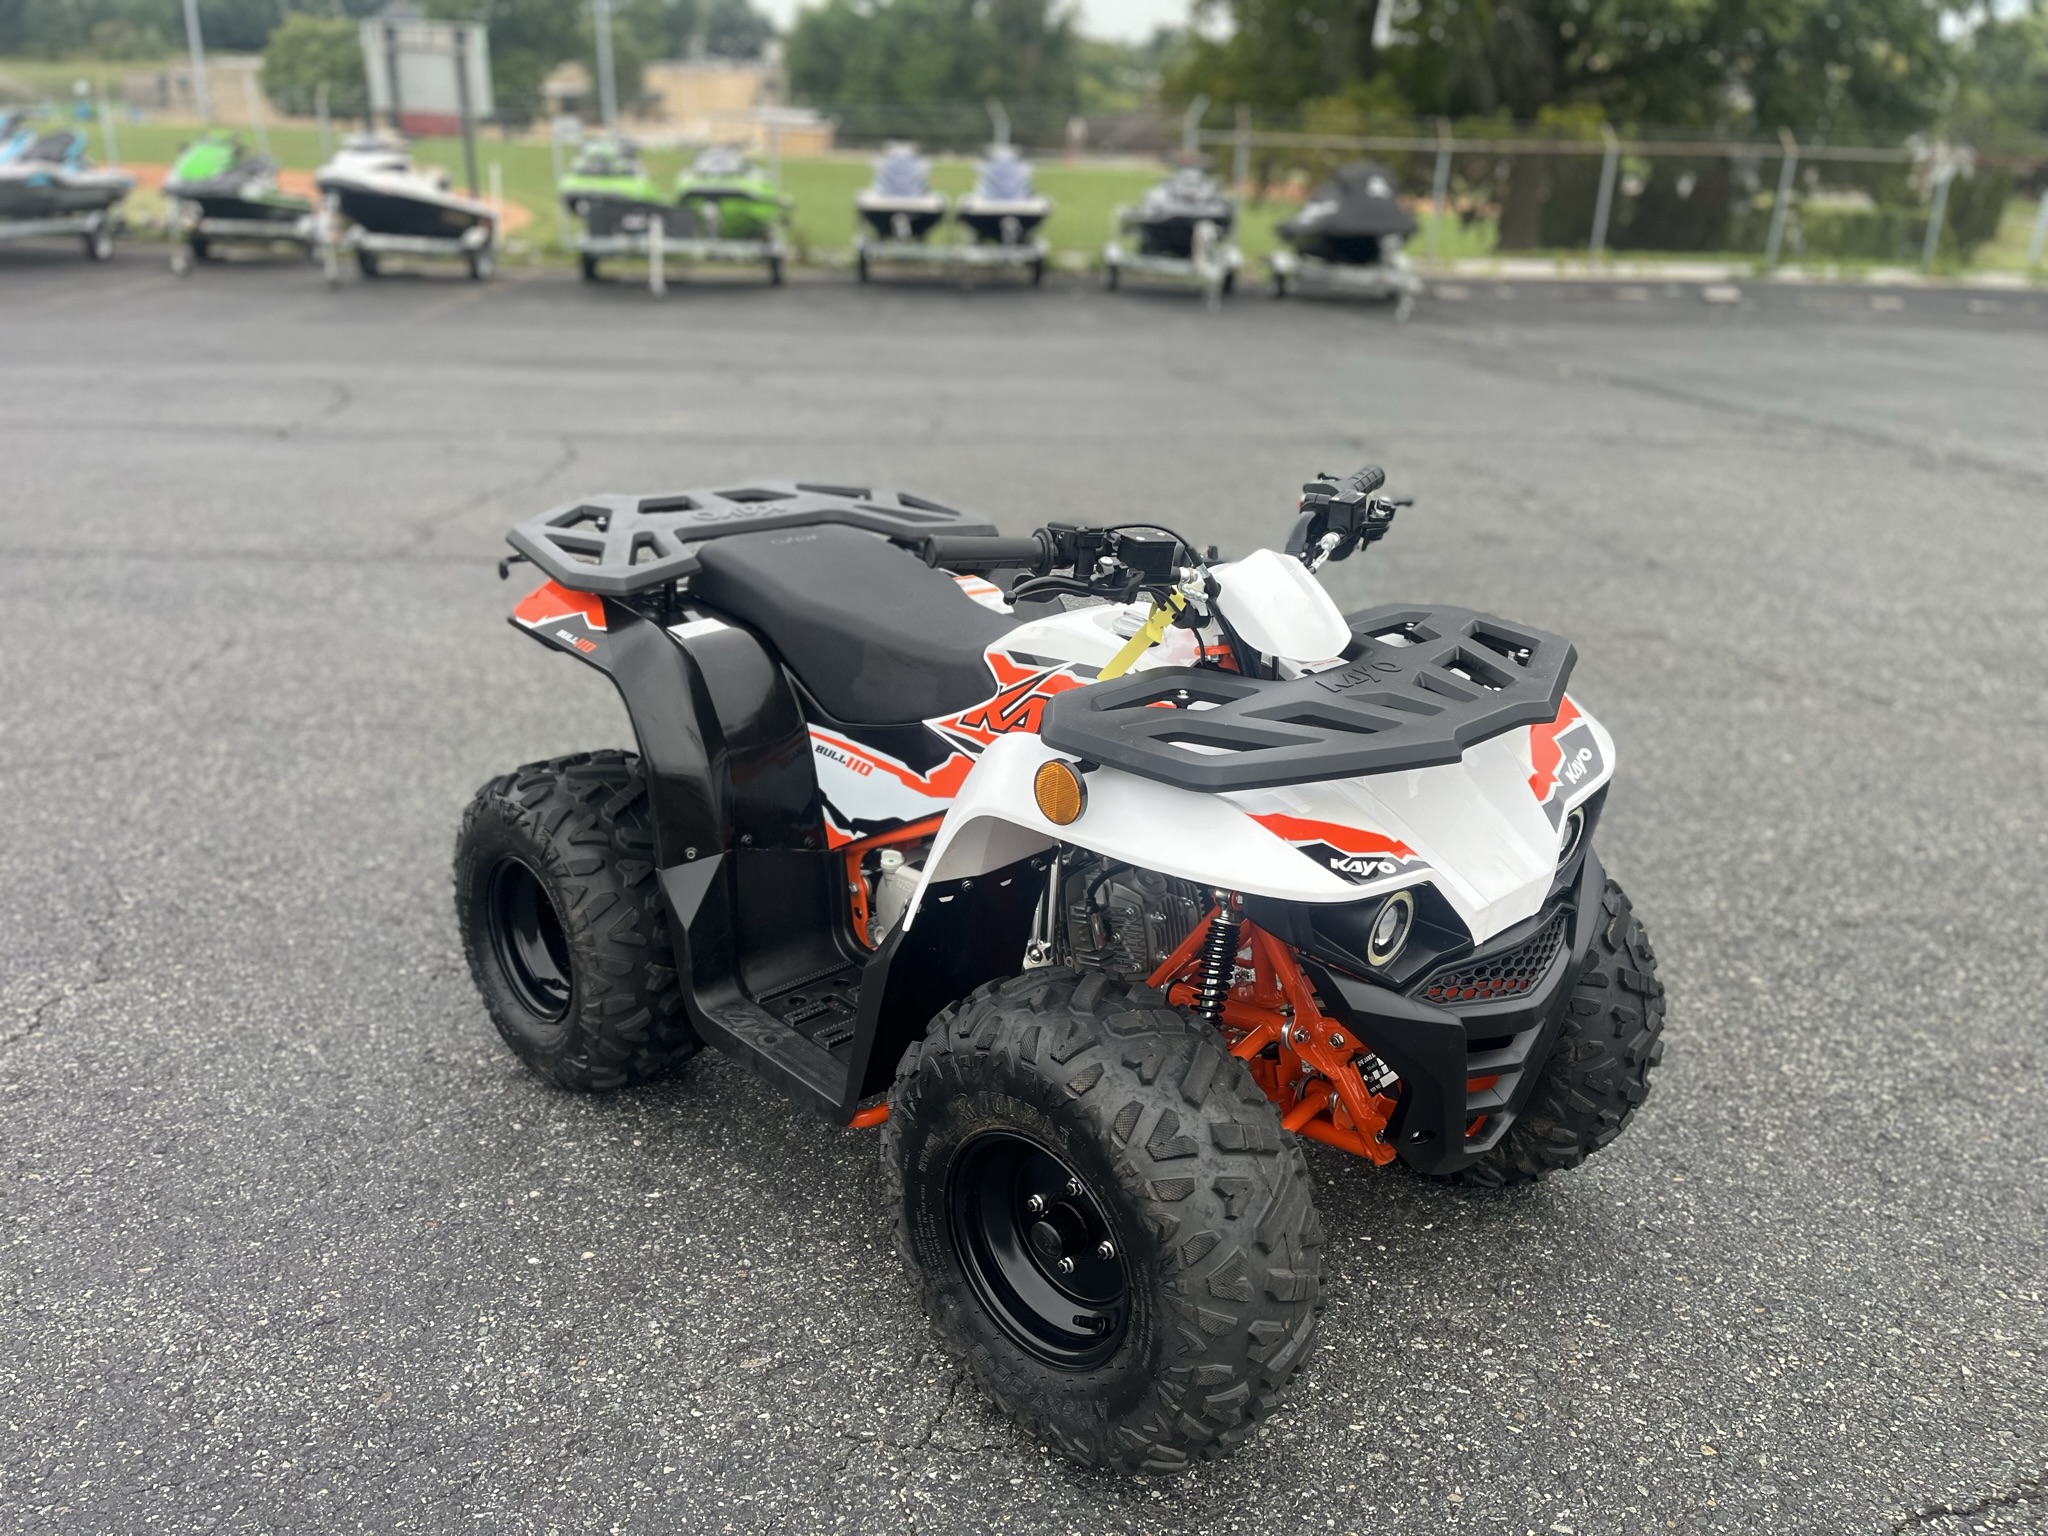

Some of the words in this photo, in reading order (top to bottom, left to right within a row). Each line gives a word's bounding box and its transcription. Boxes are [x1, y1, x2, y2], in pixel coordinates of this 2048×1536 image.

[1313, 661, 1403, 694] KAYO
[1565, 747, 1593, 785] KAYO
[1330, 857, 1397, 876] KAYO
